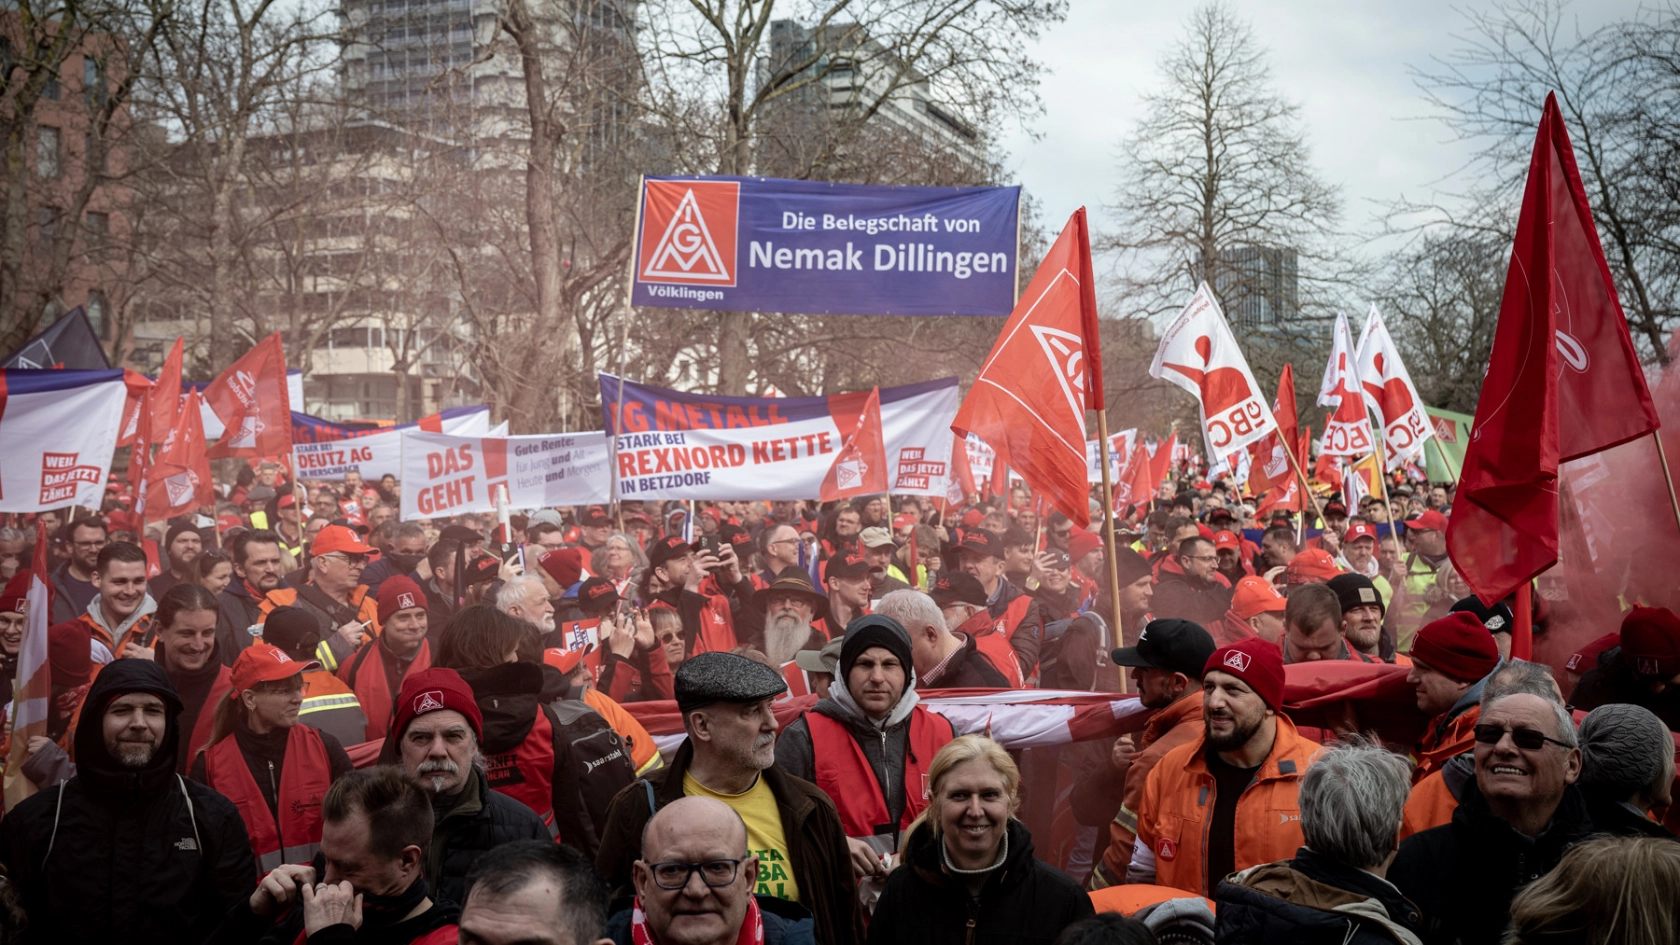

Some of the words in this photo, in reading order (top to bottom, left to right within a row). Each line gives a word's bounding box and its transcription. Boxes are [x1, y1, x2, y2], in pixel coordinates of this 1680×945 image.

[782, 211, 815, 230] Die
[823, 214, 938, 235] Belegschaft
[944, 218, 981, 233] von
[749, 241, 863, 271] Nemak
[874, 243, 1008, 279] Dillingen
[648, 284, 724, 301] Völklingen
[609, 400, 650, 435] IG
[655, 399, 788, 432] METALL
[296, 444, 318, 453] STARK
[320, 443, 333, 451] BEI
[515, 443, 539, 457] Gute
[541, 437, 575, 451] Rente:
[617, 433, 662, 451] STARK
[664, 433, 686, 445] BEI
[46, 456, 75, 468] WEIL
[297, 450, 346, 469] DEUTZ
[351, 446, 373, 463] AG
[426, 443, 474, 480] DAS
[516, 460, 529, 473] für
[530, 458, 550, 472] Jung
[551, 451, 571, 465] und
[573, 449, 586, 461] Alt
[617, 443, 746, 478] REXNORD
[752, 431, 833, 465] KETTE
[901, 450, 922, 460] WEIL
[44, 473, 67, 486] DAS
[65, 468, 99, 483] JETZT
[299, 468, 308, 477] IN
[517, 475, 543, 489] Heute
[545, 468, 565, 483] und
[900, 463, 917, 474] DAS
[917, 463, 944, 475] JETZT
[620, 479, 637, 495] IN
[639, 471, 711, 492] BETZDORF
[41, 486, 74, 503] ZÄHLT.
[417, 475, 475, 515] GEHT
[592, 749, 623, 768] saarstahl
